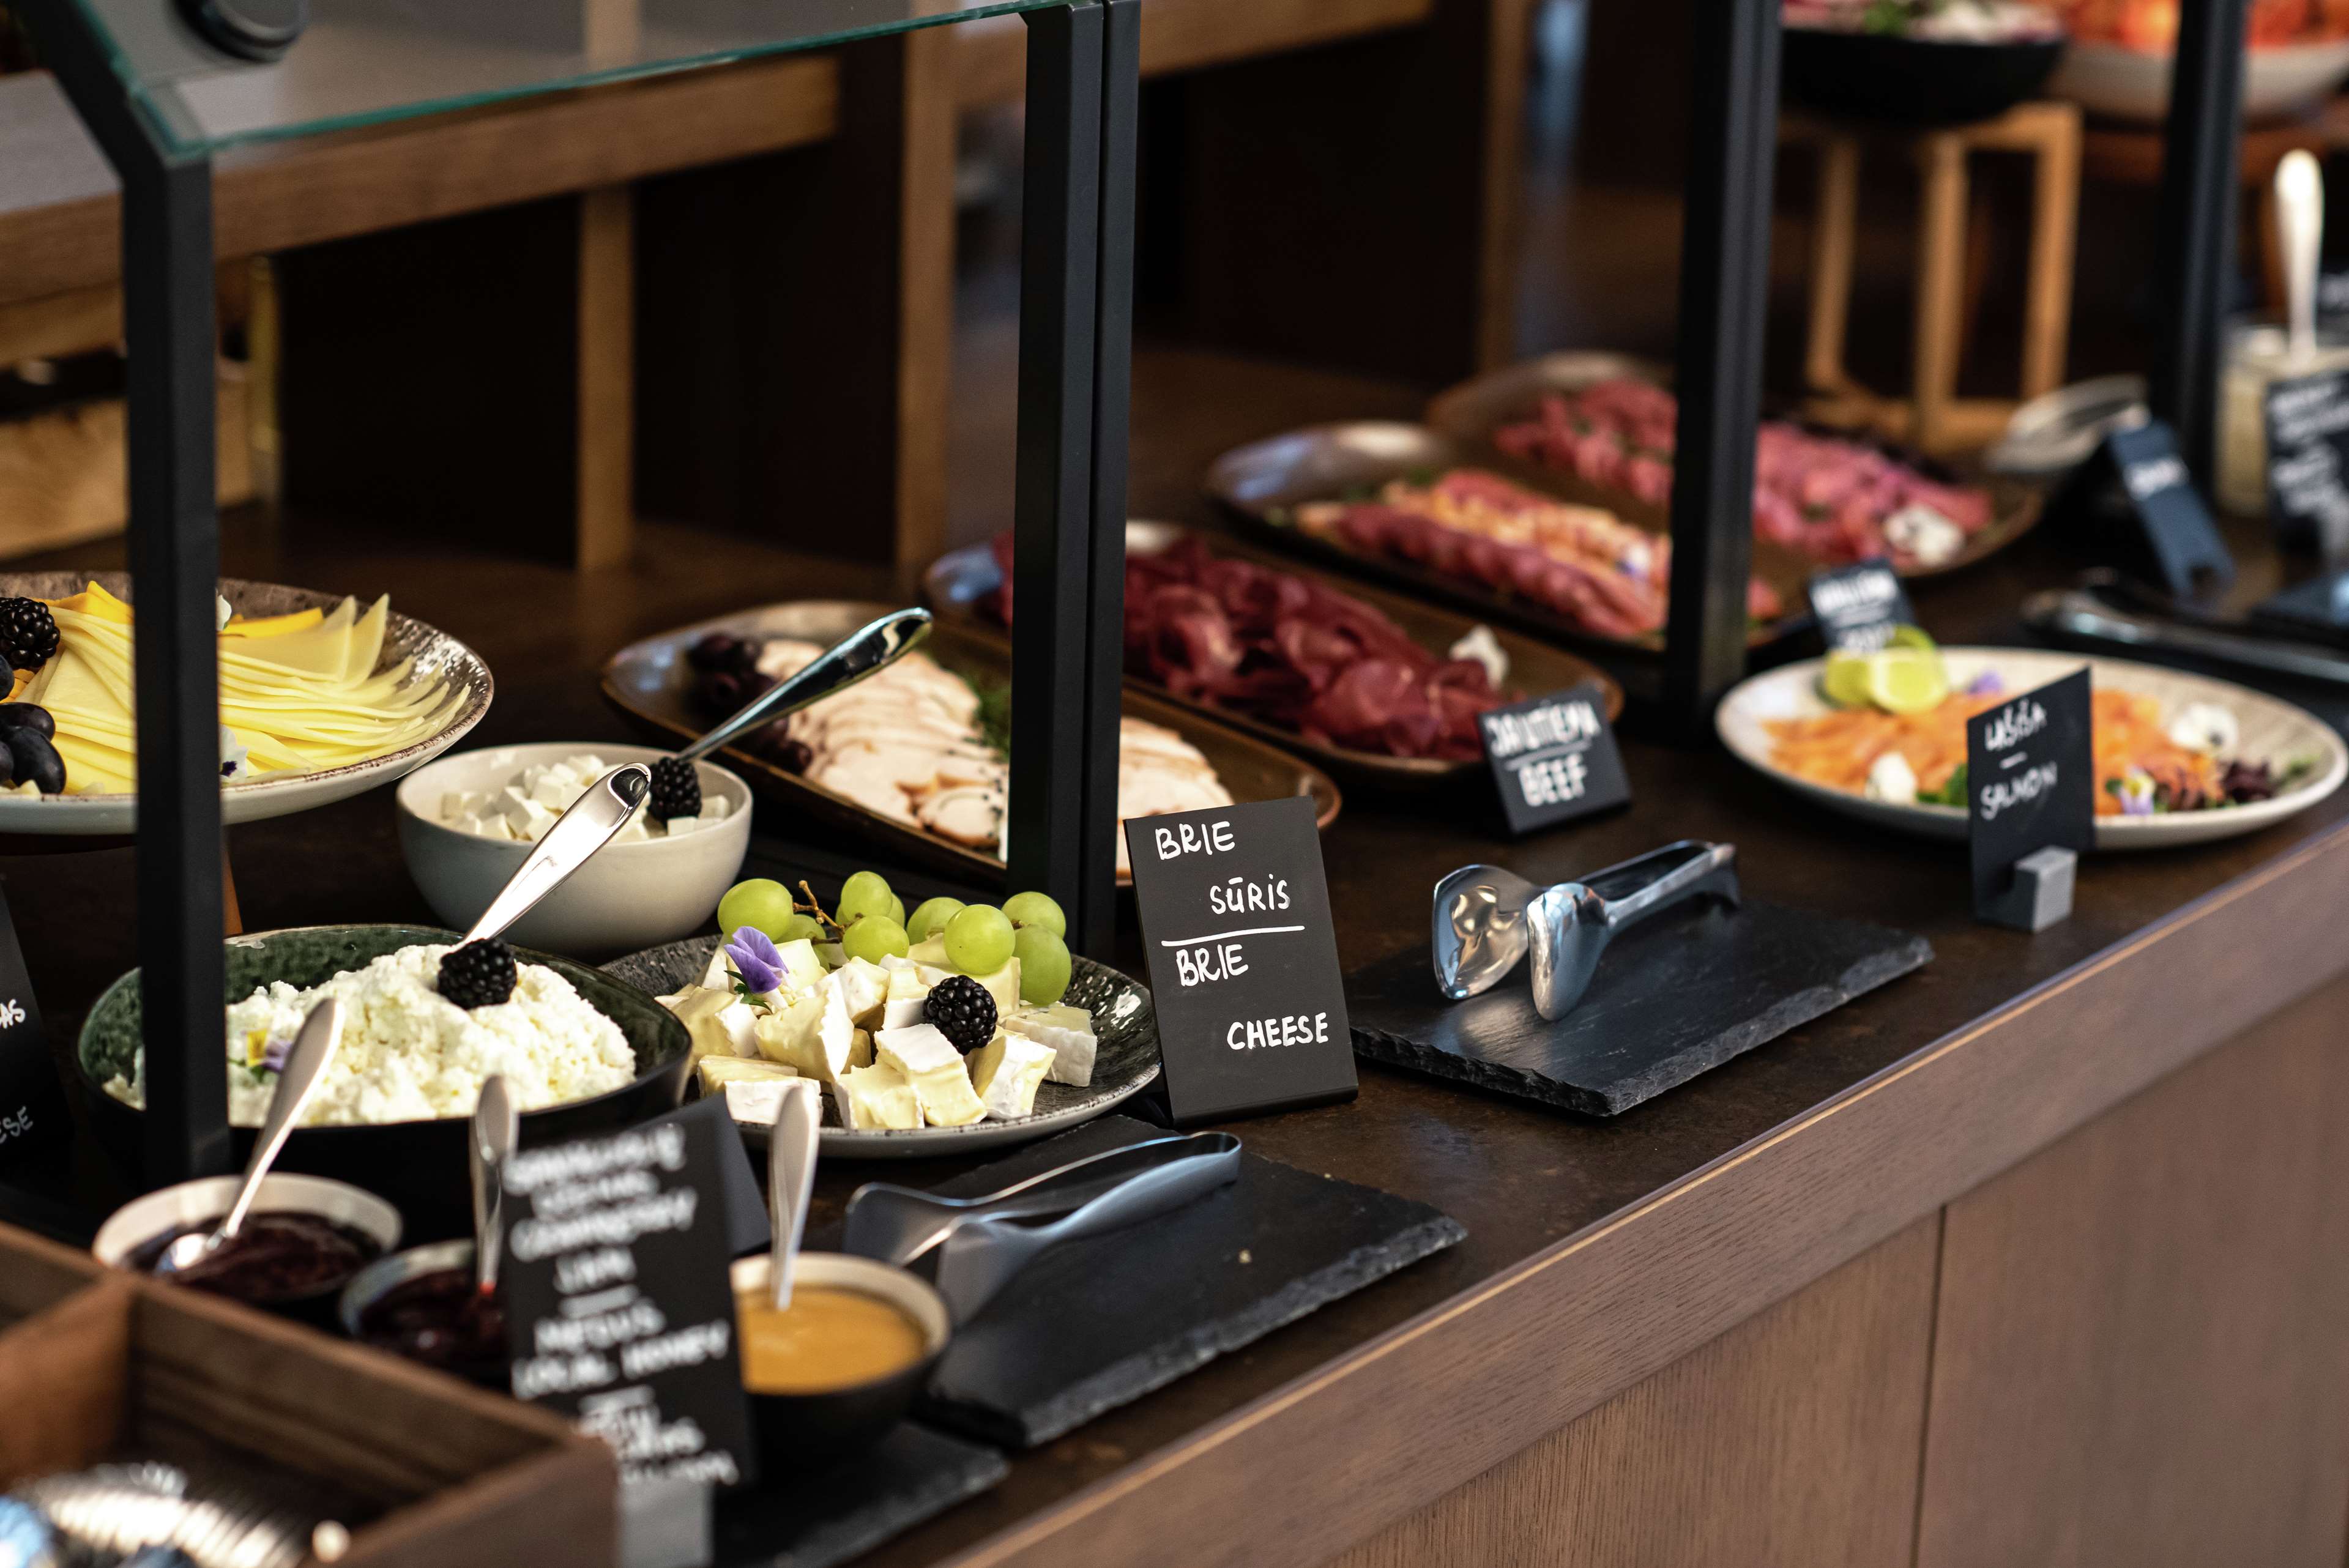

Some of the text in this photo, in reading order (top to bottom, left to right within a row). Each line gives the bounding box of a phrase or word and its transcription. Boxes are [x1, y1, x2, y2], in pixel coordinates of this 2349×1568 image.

[1519, 752, 1588, 806] BEEF
[1155, 820, 1235, 860] BRIE
[1176, 943, 1249, 987] BRIE
[1227, 1012, 1328, 1050] CHEESE
